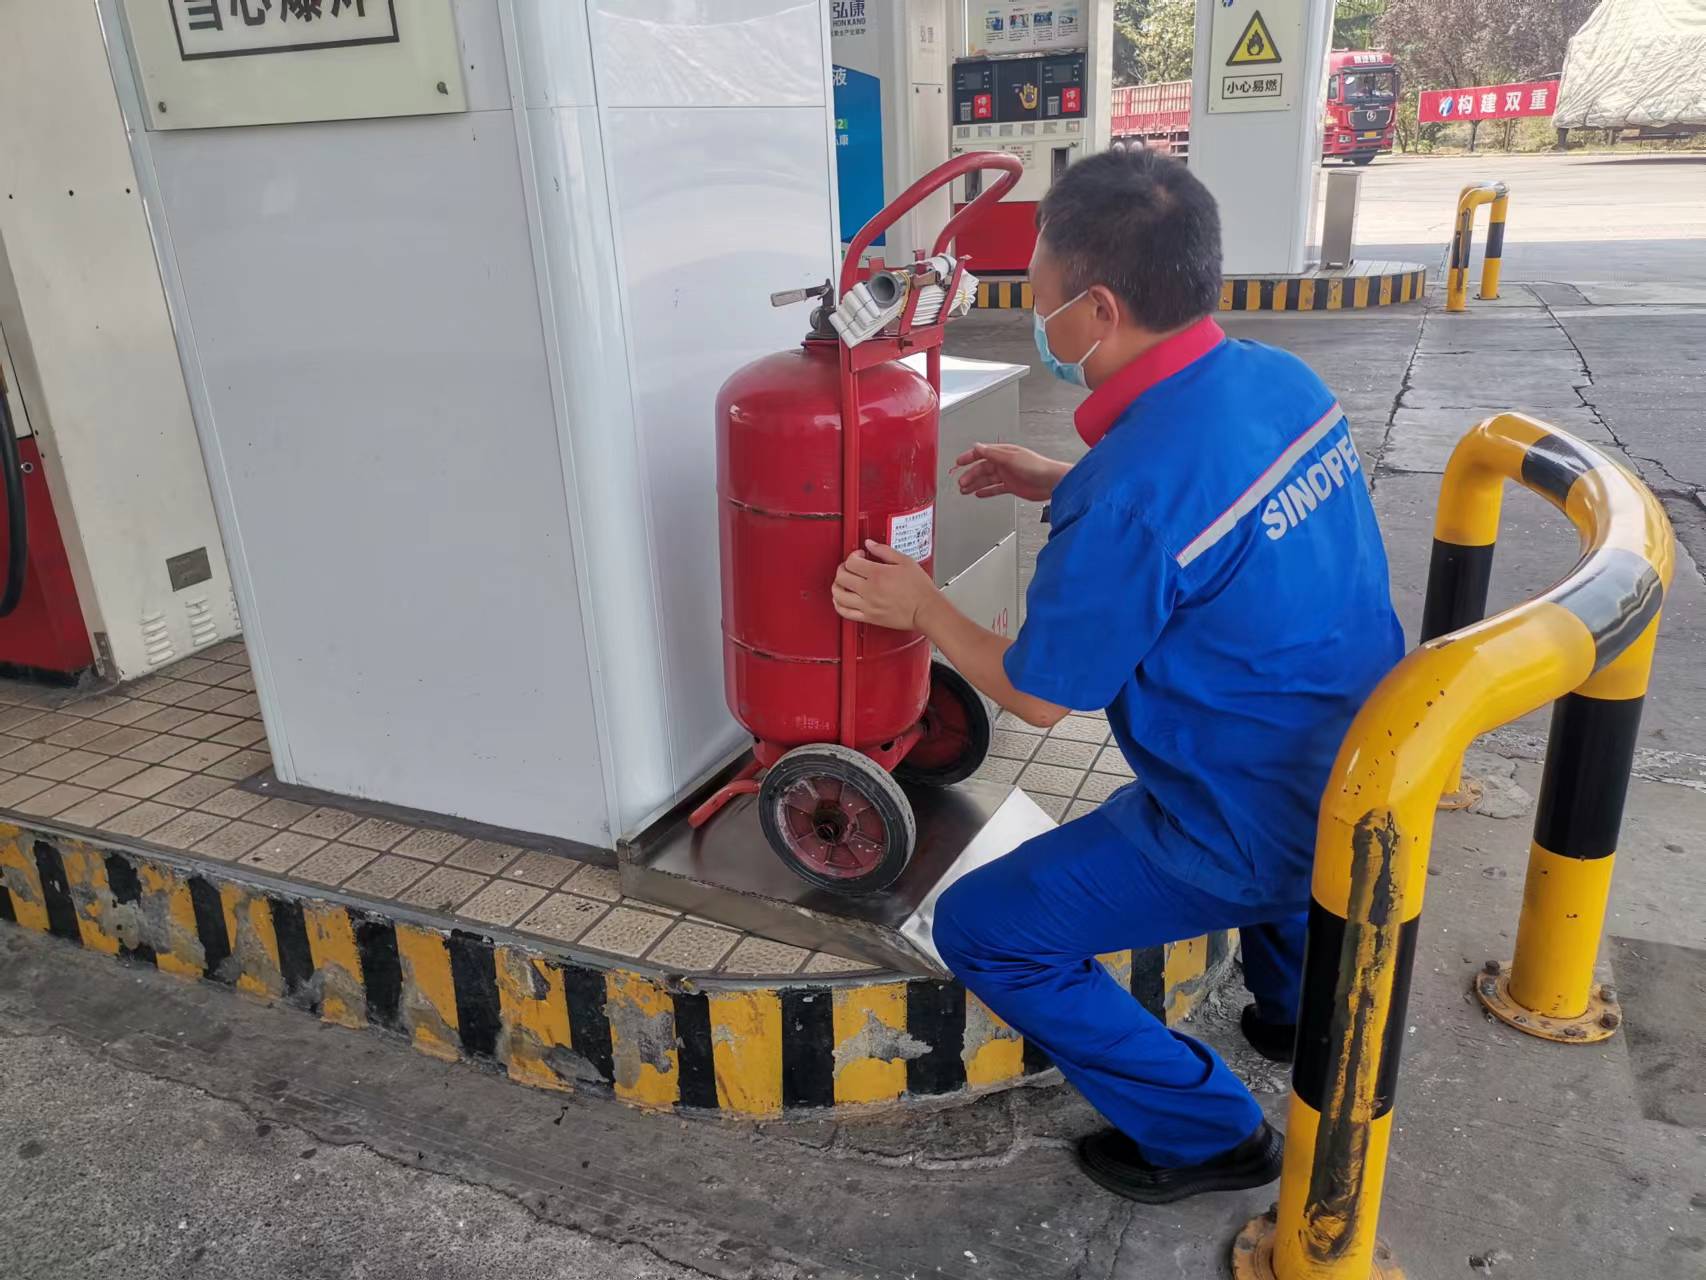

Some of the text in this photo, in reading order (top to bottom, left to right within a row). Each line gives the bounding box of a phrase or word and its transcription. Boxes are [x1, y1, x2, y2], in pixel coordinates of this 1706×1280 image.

[1226, 79, 1278, 94] 小心易燃
[1457, 89, 1548, 115] 构建双重
